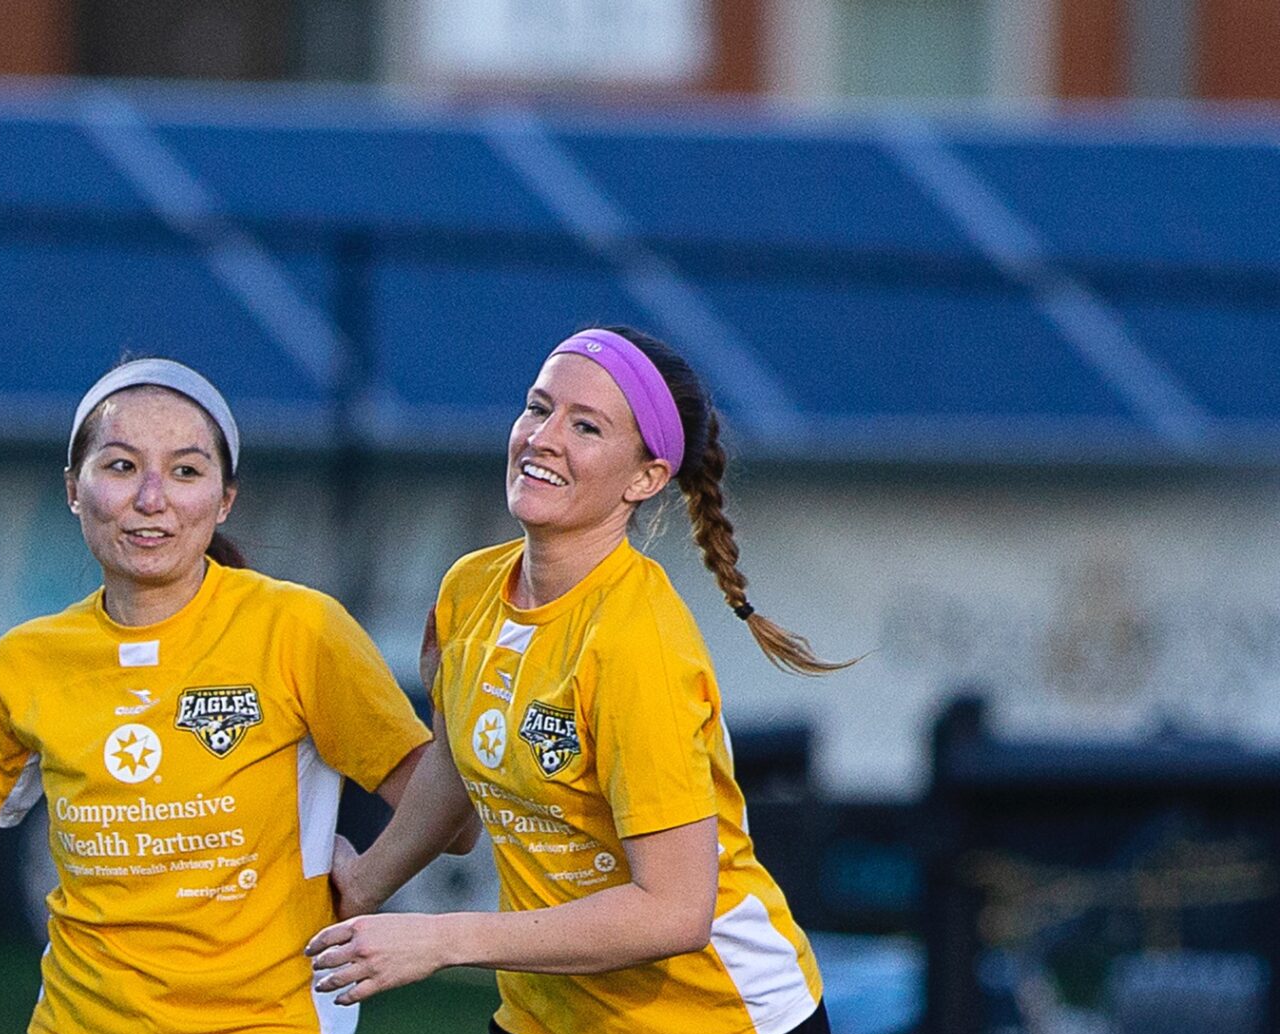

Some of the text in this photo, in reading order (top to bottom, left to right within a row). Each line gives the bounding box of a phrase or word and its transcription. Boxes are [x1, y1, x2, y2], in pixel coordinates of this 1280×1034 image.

[179, 691, 260, 723] EAGLES
[521, 708, 577, 737] EAGLE
[56, 794, 236, 828] Comprehensive
[57, 827, 245, 858] Wealth Partners
